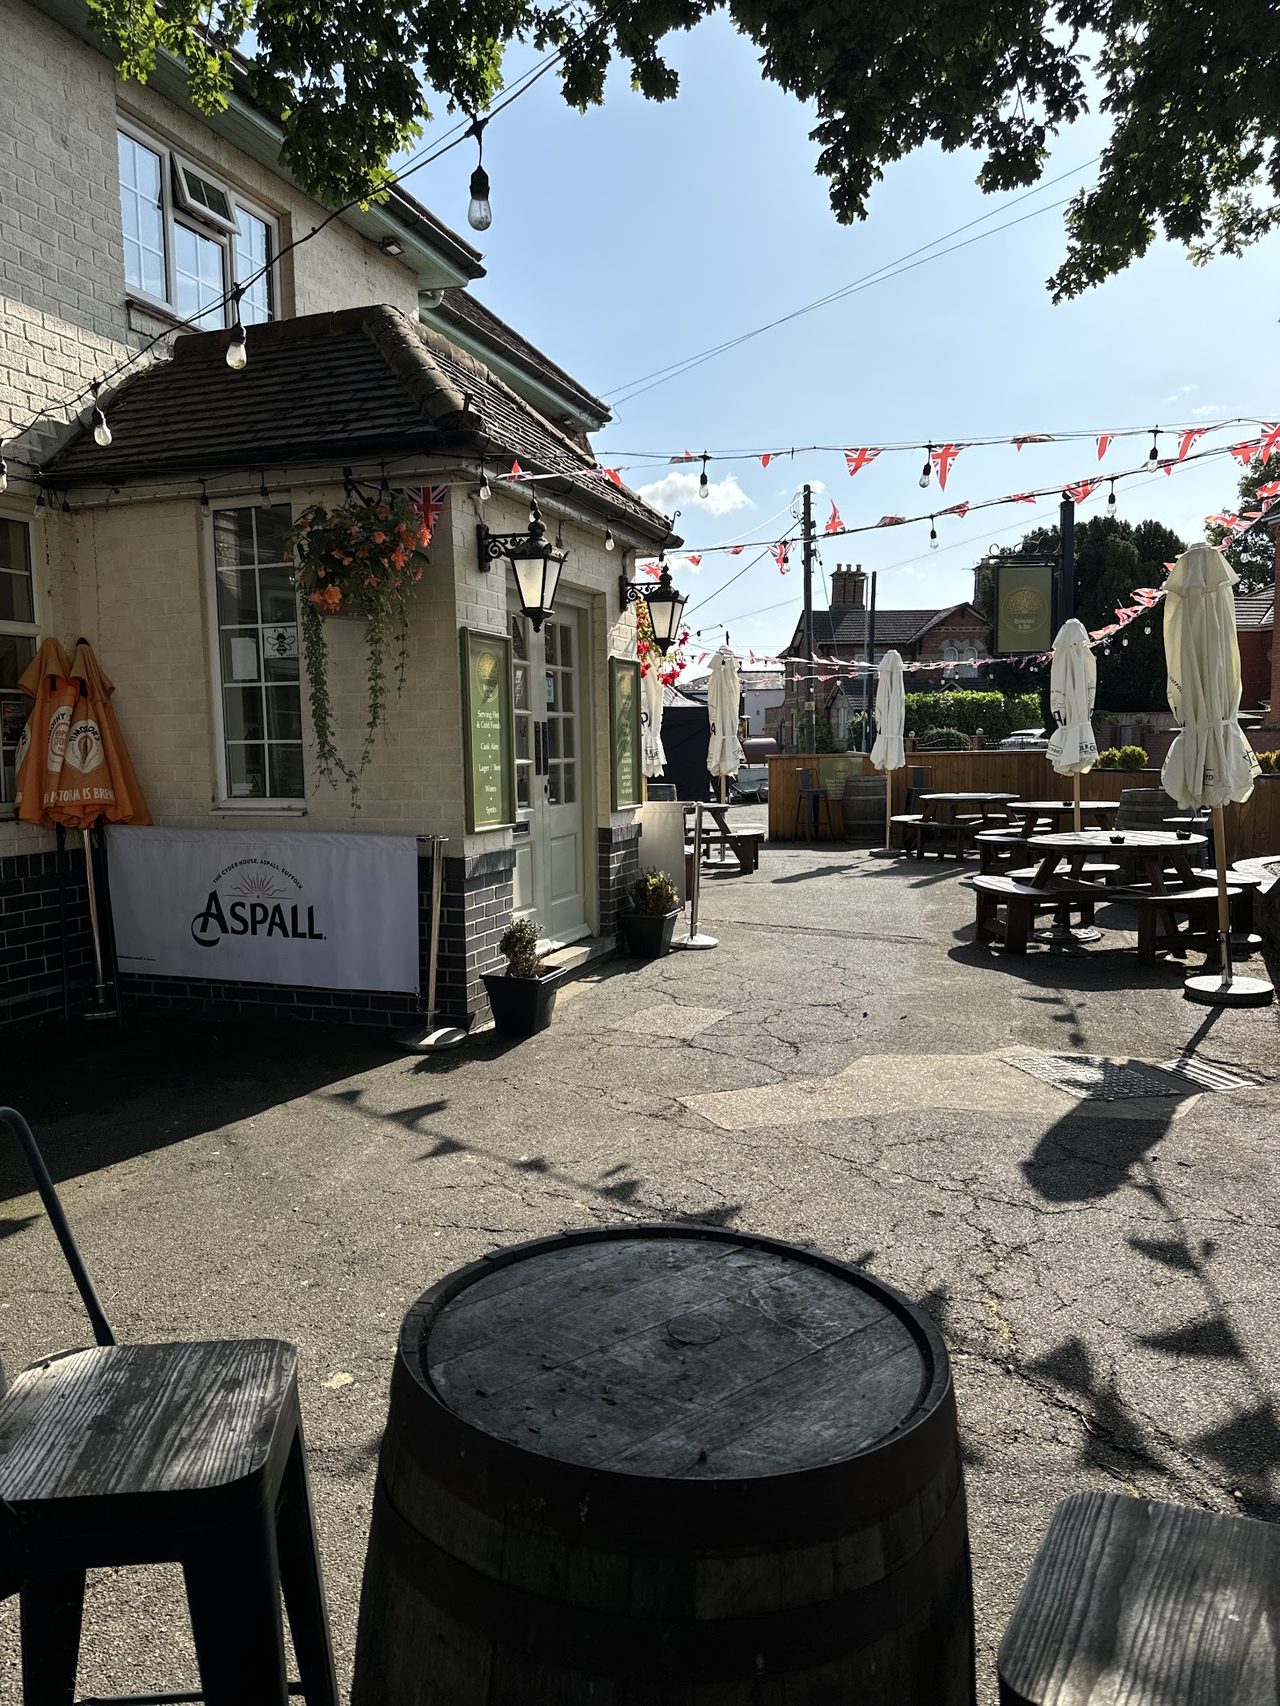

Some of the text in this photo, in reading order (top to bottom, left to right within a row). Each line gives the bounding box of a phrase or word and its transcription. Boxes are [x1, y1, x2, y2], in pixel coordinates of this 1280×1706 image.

[480, 721, 490, 729] Cold
[478, 763, 490, 774] Lager
[82, 787, 92, 800] IS
[212, 873, 223, 884] THE
[221, 862, 238, 876] CYDER
[281, 867, 303, 891] SUFFOLK
